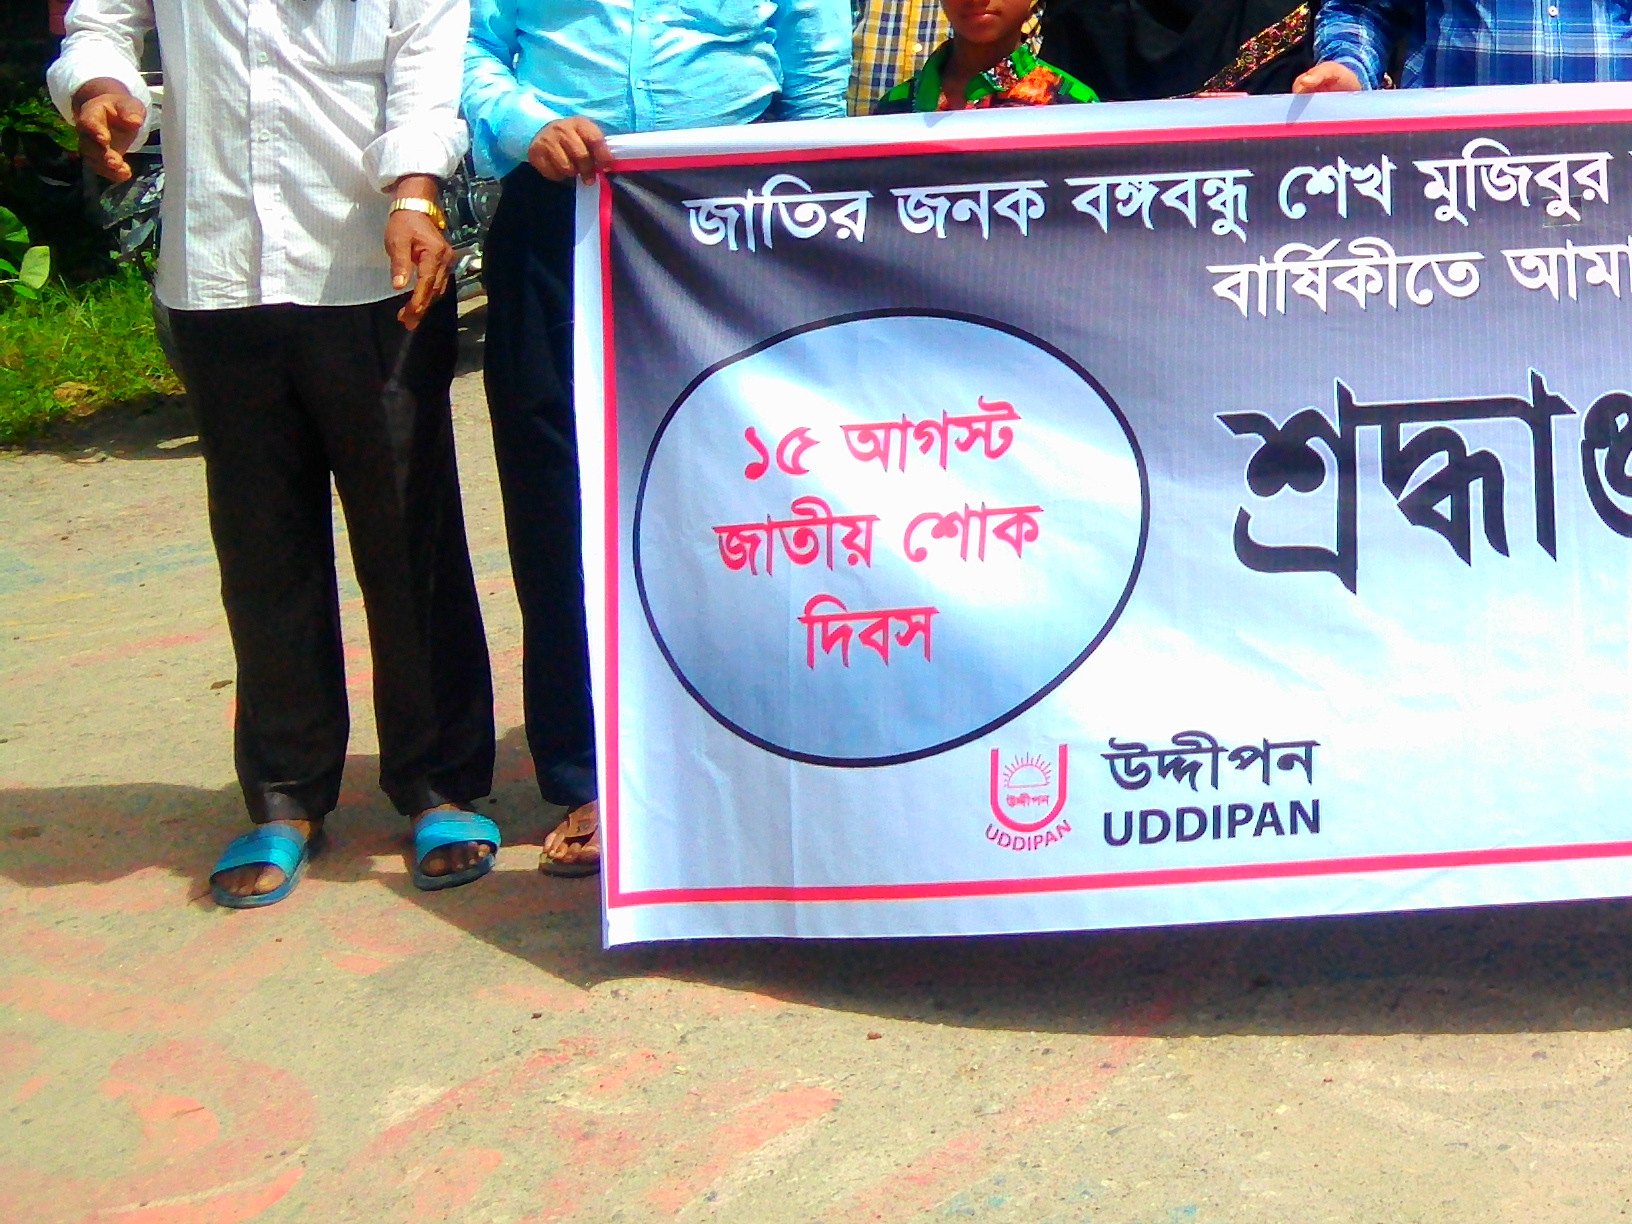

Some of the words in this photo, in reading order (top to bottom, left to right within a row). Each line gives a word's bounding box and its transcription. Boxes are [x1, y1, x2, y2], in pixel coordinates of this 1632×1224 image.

[684, 174, 874, 253] জাতির
[890, 179, 1048, 242] জনক
[1065, 169, 1255, 244] বঙ্গবন্ধু
[1278, 154, 1398, 221] শেখ
[1412, 137, 1615, 228] মুজিবুর
[1206, 237, 1485, 319] বার্ষিকীতে
[743, 425, 820, 481] ১৫
[841, 395, 1022, 474] আগস্ট
[713, 495, 879, 576] জাতীয়
[903, 501, 1044, 564] শোক
[798, 593, 939, 671] দিবস
[1100, 730, 1322, 792] উদ্দীপন
[984, 819, 1073, 852] UDDIPAN
[1103, 799, 1321, 847] UDDIPAN
